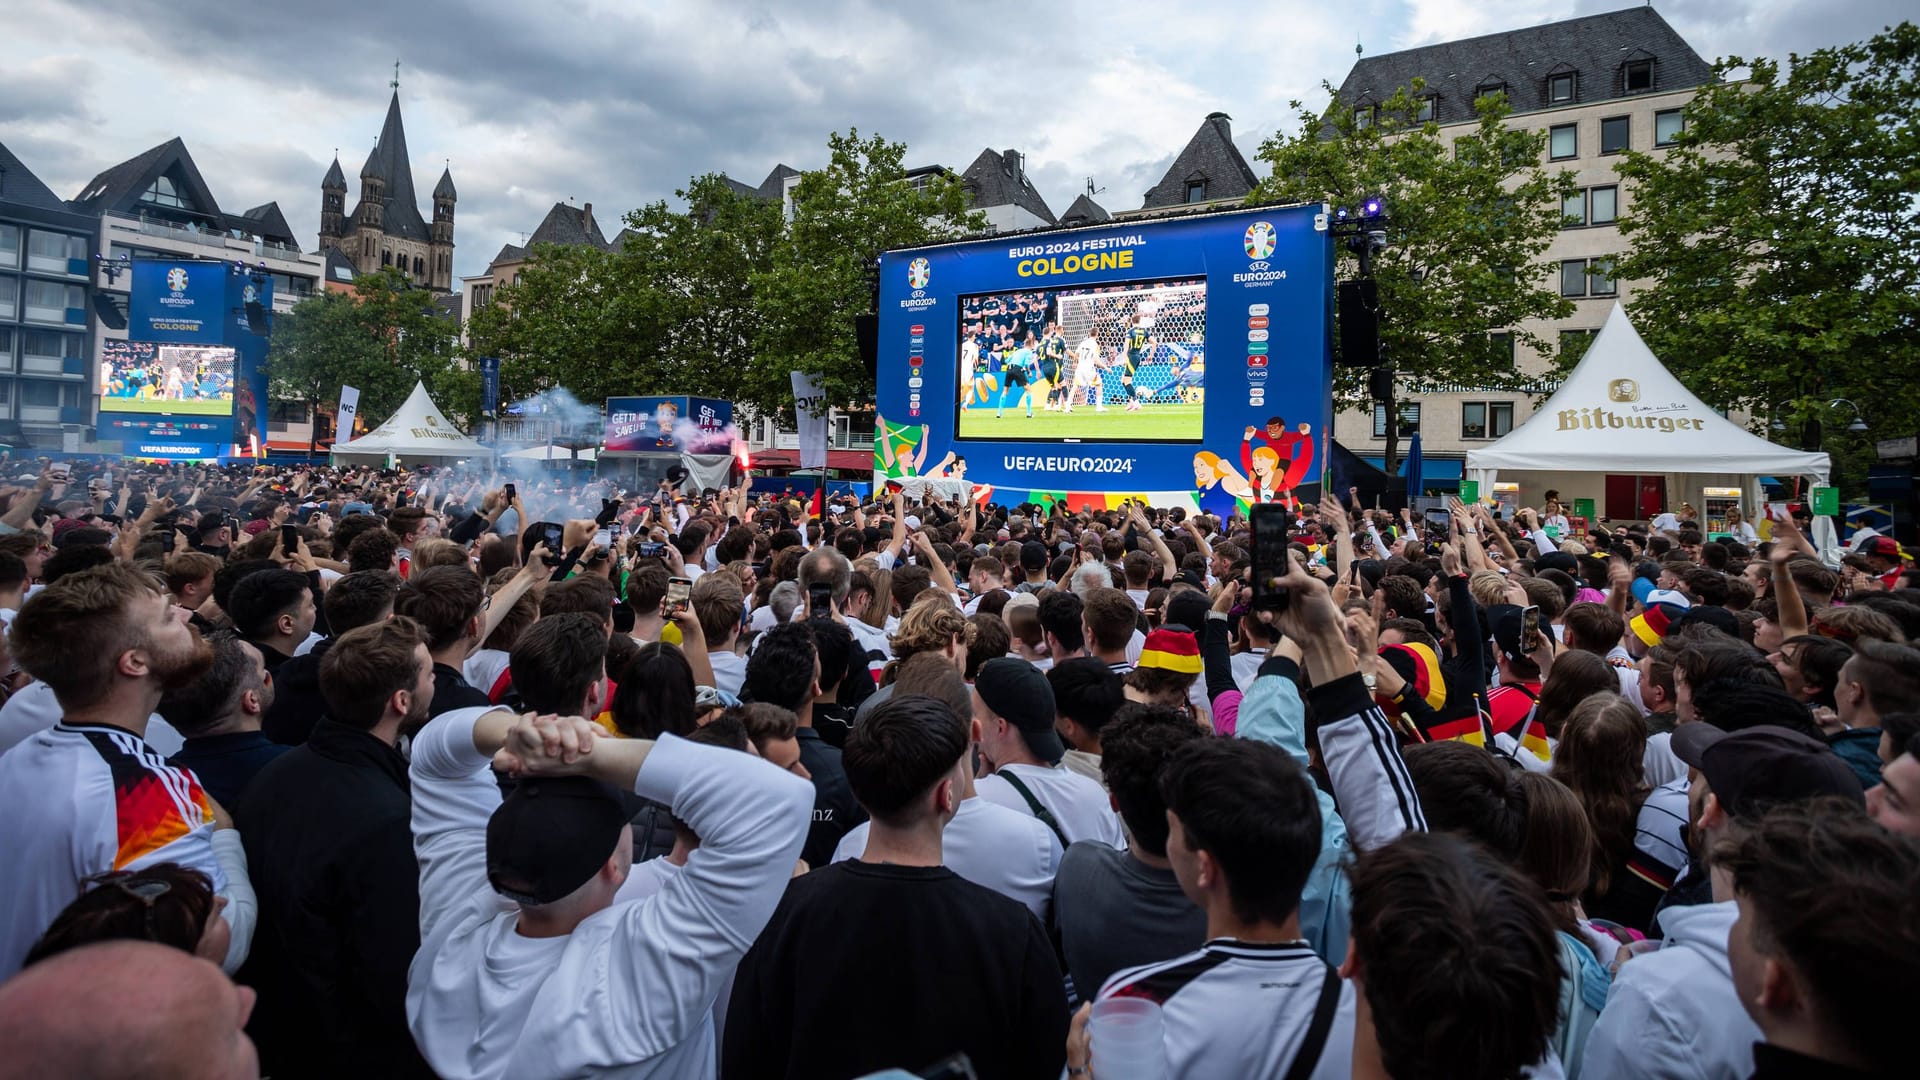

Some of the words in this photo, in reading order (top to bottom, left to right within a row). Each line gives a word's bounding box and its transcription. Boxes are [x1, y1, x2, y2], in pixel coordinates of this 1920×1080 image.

[1009, 245, 1044, 258] EURO
[1045, 241, 1081, 255] 2024
[1082, 235, 1146, 251] FESTIVAL
[1017, 250, 1134, 277] COLOGNE
[1248, 260, 1271, 272] UEFA
[1233, 270, 1287, 282] EURO2024
[900, 297, 936, 308] EURO2024
[153, 323, 199, 332] COLOGNE
[341, 402, 355, 413] WC
[700, 404, 716, 418] GET
[612, 412, 628, 424] GET
[1556, 406, 1705, 433] Bitburger
[410, 427, 463, 442] Bitburger
[614, 424, 633, 438] SAVE
